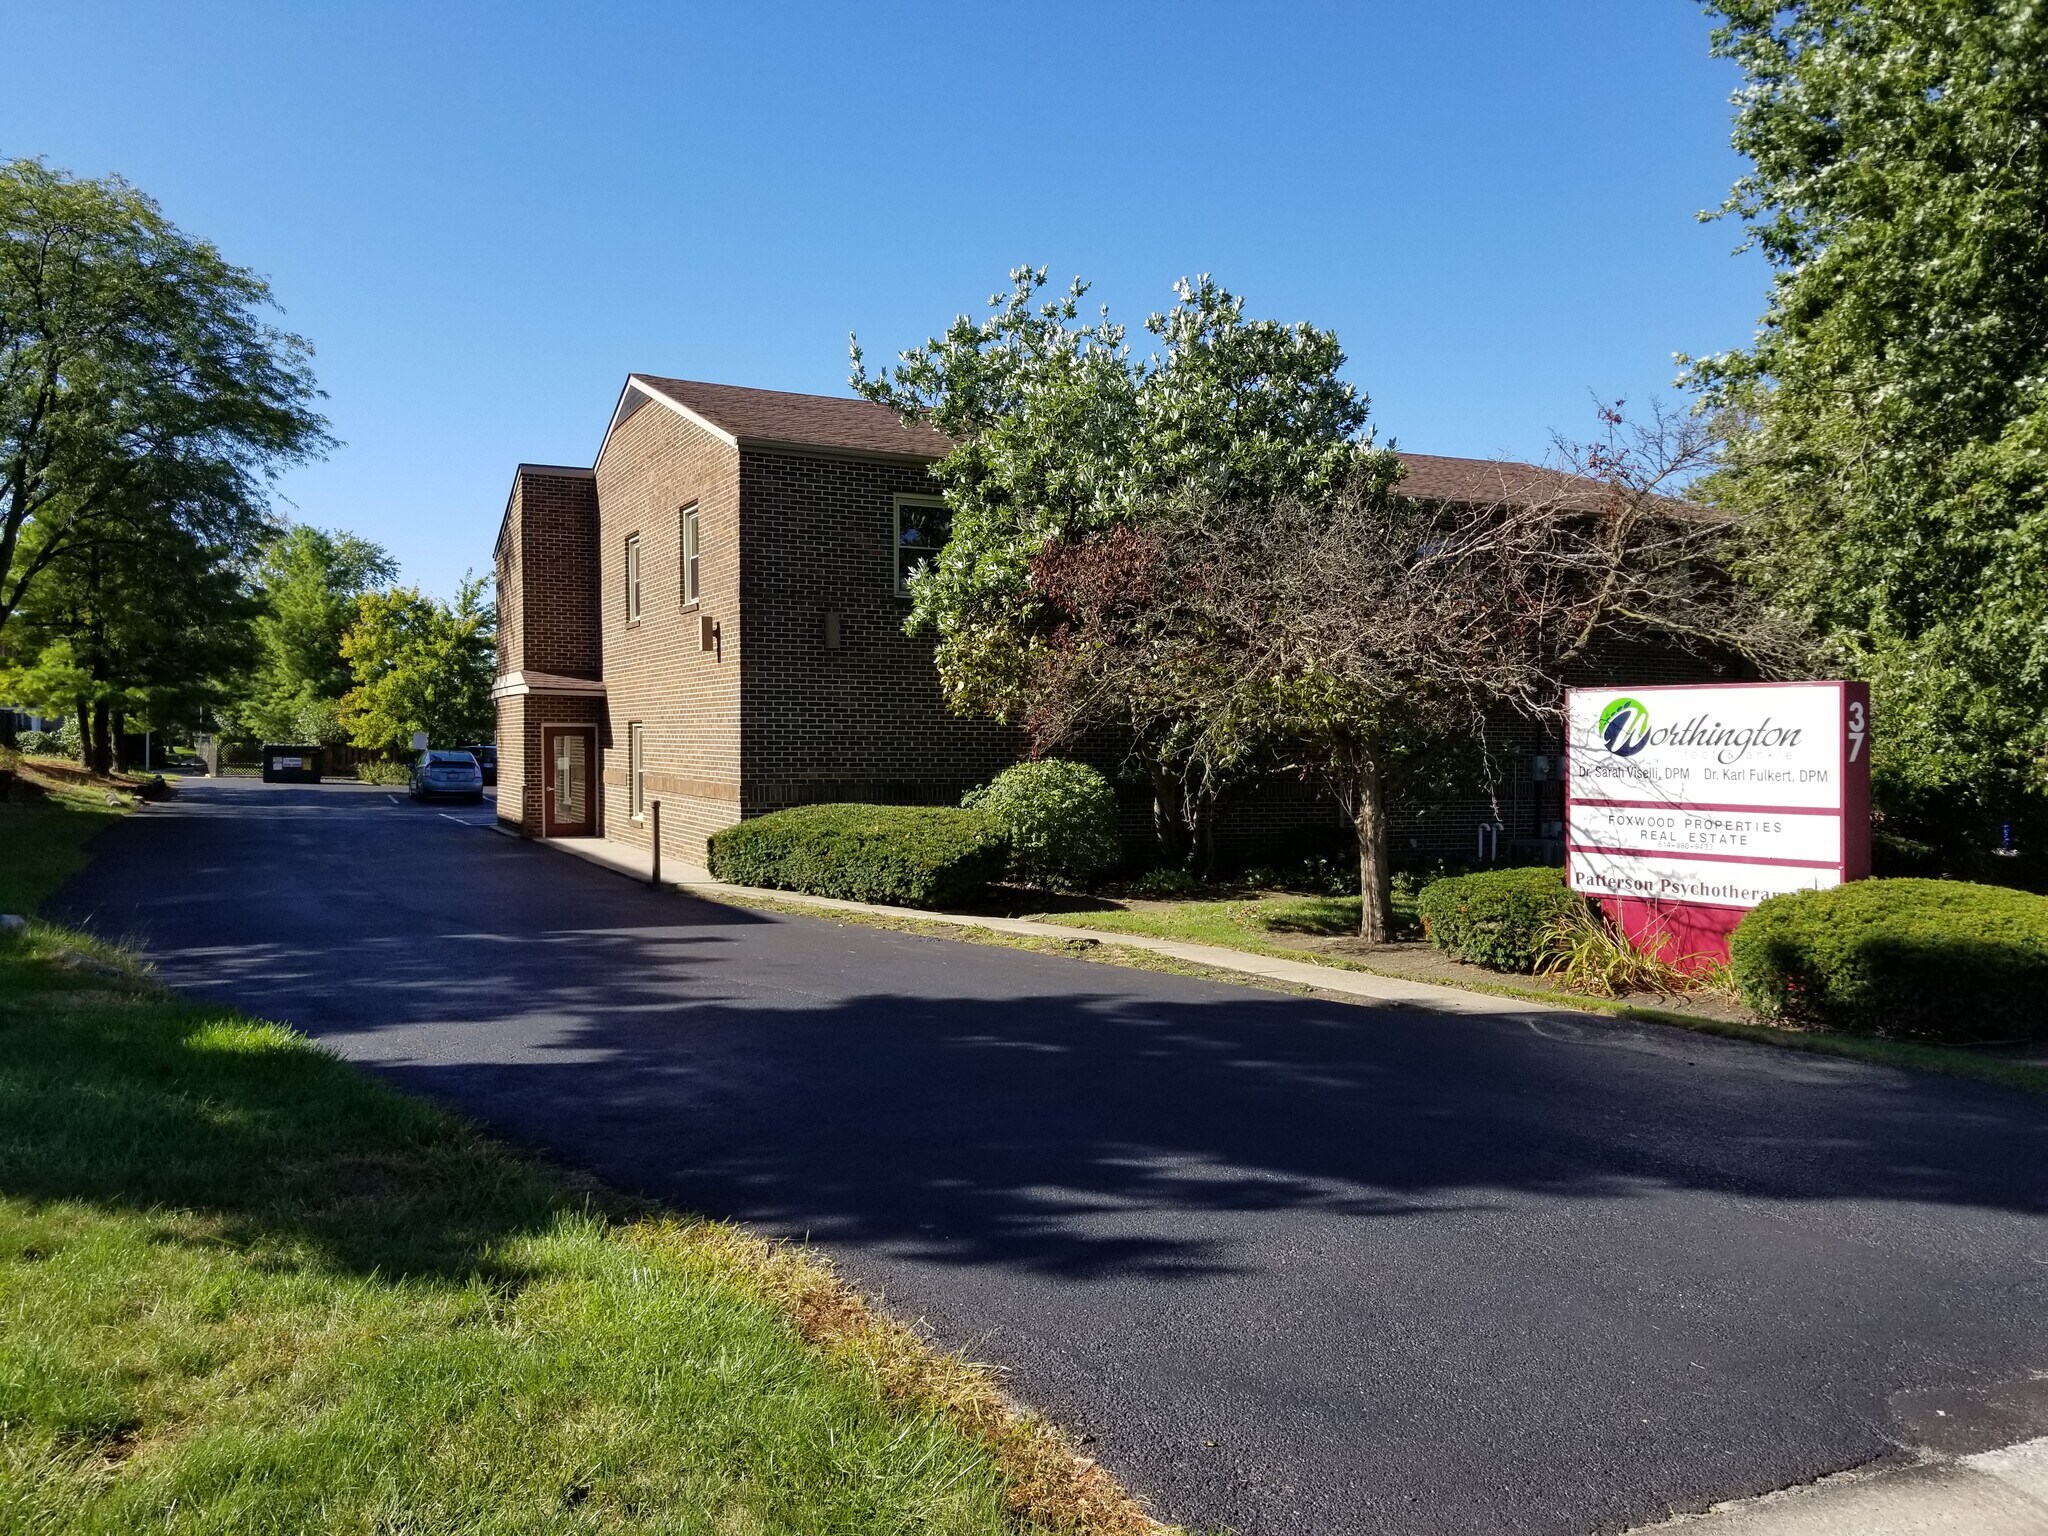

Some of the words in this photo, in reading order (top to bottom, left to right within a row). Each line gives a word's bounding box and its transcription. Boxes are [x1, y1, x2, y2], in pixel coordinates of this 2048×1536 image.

[1601, 705, 1803, 765] Worthington
[1849, 702, 1865, 763] 37
[1579, 766, 1592, 778] Dr.
[1595, 766, 1625, 779] Sarah
[1627, 766, 1661, 780] Viselli,
[1665, 767, 1690, 780] DPM
[1704, 768, 1719, 781] Dr.
[1723, 769, 1745, 781] Karl
[1750, 769, 1796, 784] Fulkert,
[1800, 770, 1828, 783] DPM
[1608, 815, 1675, 828] FOXWOOD
[1684, 818, 1783, 833] PROPERTIES
[1640, 829, 1676, 842] REAL
[1689, 832, 1749, 846] ESTATE
[1575, 872, 1653, 891] Patterson
[1661, 878, 1797, 901] Psychothera
